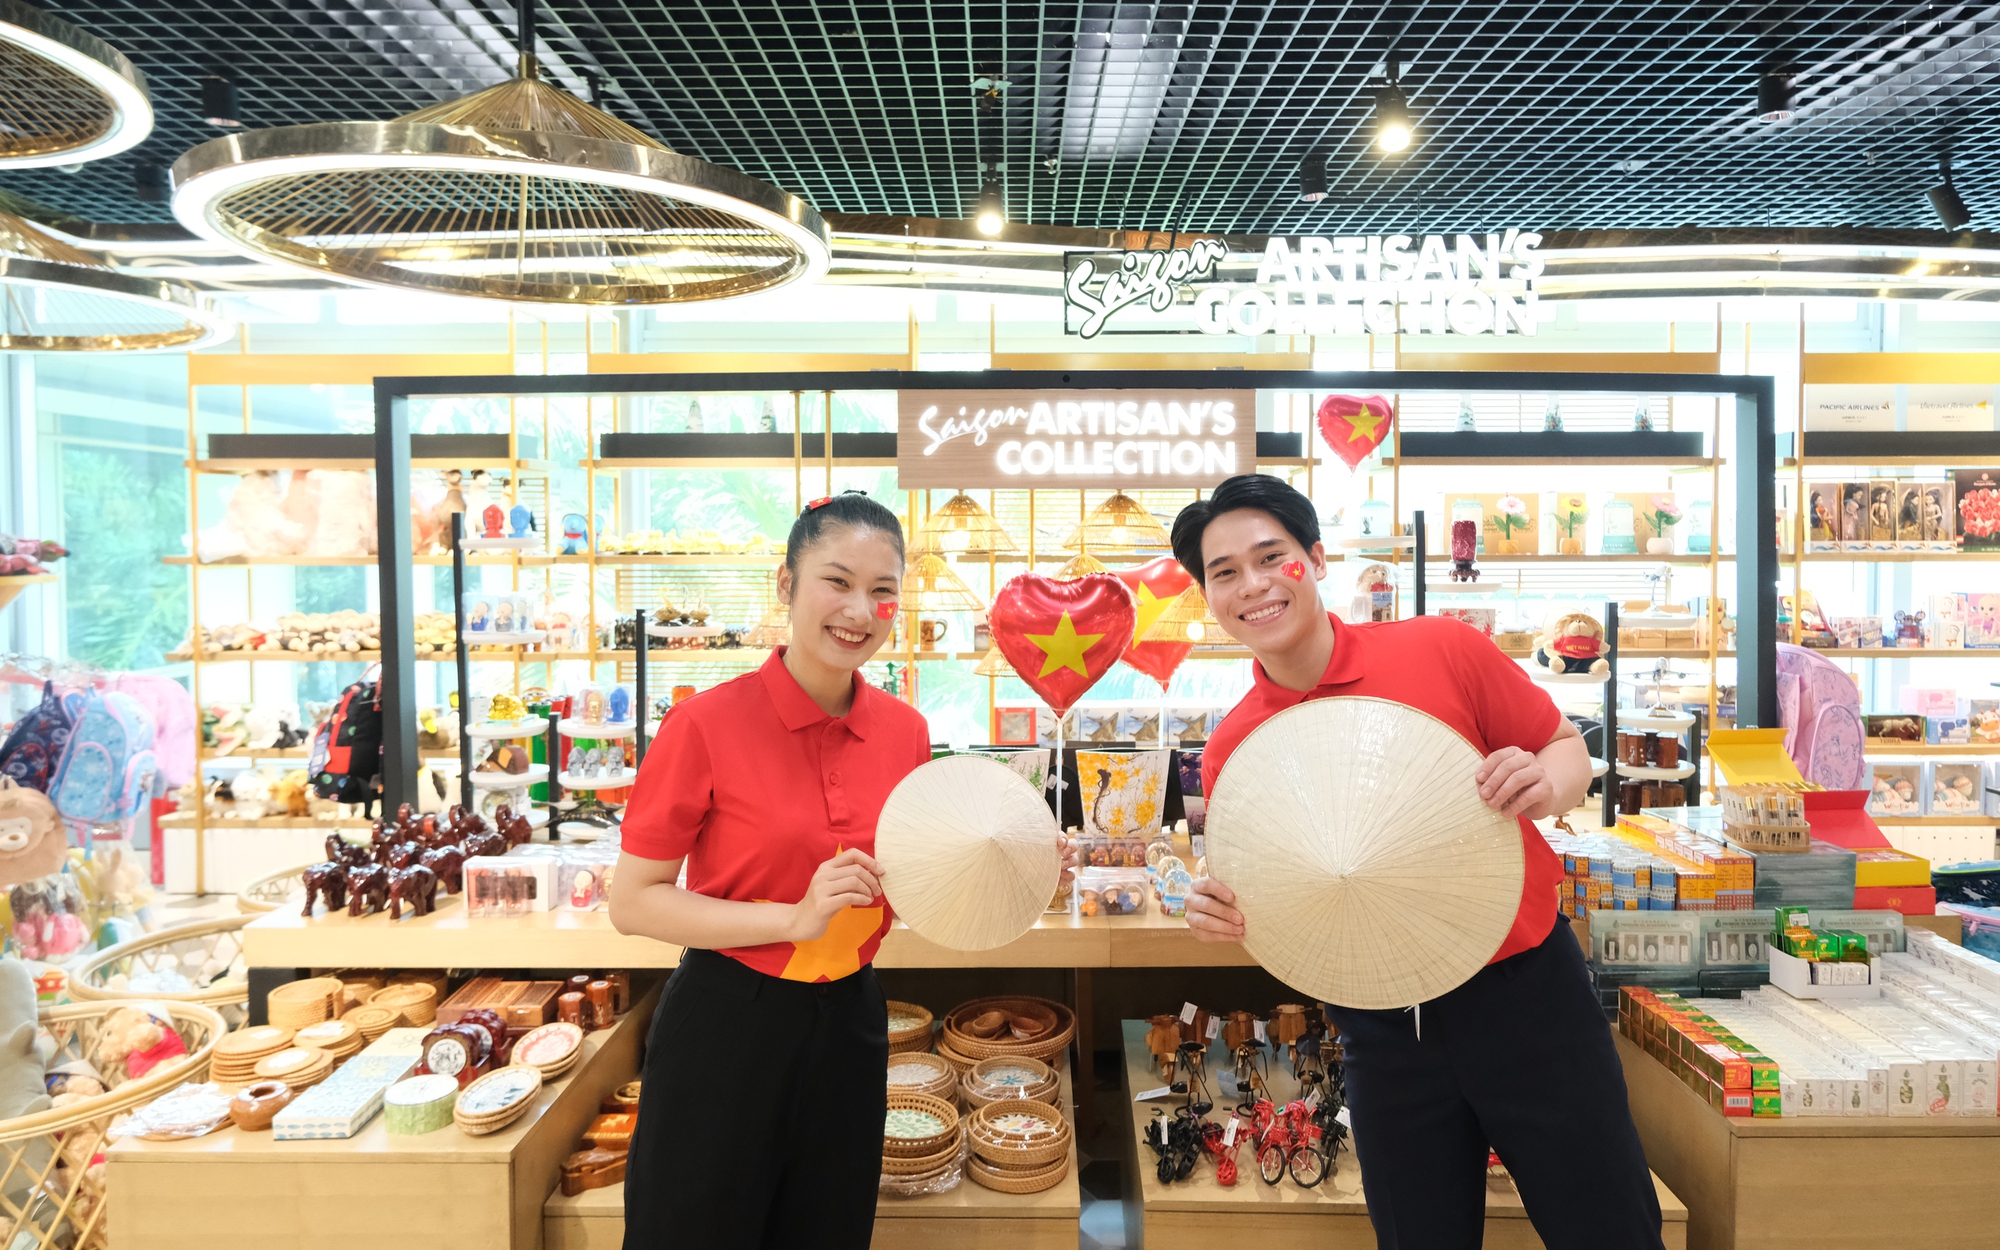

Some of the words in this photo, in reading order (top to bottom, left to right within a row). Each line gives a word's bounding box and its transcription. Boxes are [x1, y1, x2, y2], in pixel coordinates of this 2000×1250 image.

[1066, 236, 1229, 340] Saigon
[1257, 229, 1545, 284] ARTISAN'S
[1195, 288, 1538, 337] COLLECTION
[918, 406, 1028, 456] Saigon
[1025, 401, 1237, 435] ARTISAN'S
[997, 441, 1236, 474] COLLECTION
